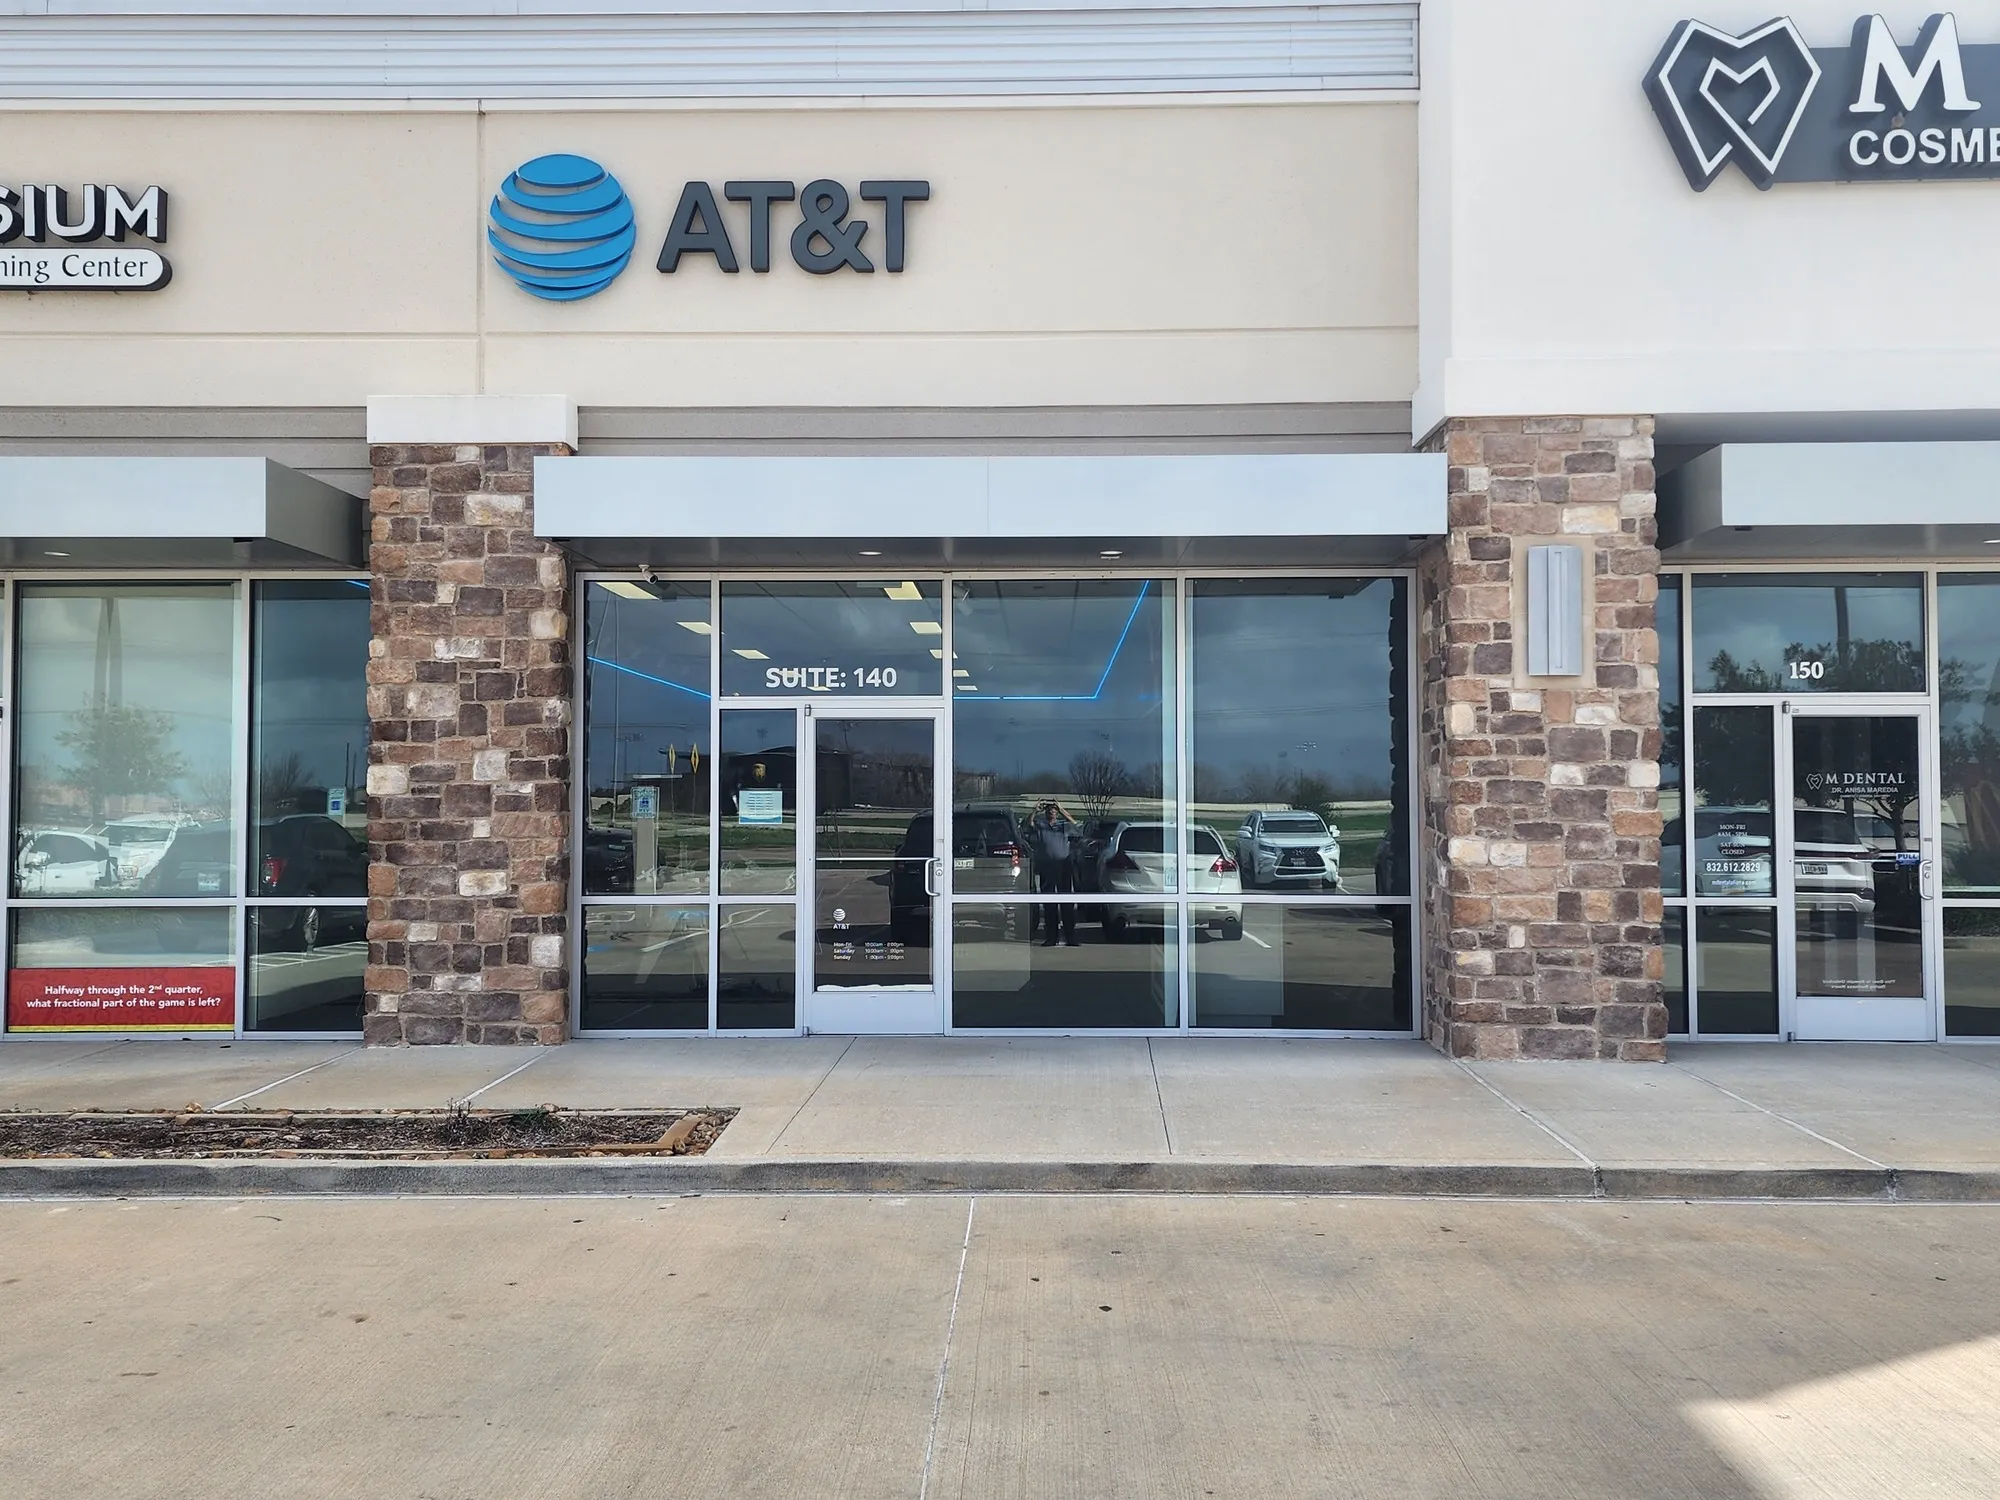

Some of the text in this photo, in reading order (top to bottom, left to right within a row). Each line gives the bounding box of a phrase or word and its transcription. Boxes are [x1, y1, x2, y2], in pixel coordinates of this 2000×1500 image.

[1849, 12, 1982, 112] M
[656, 179, 930, 274] AT&T
[62, 254, 148, 277] Center
[765, 667, 897, 688] SUITE: 140
[1789, 661, 1824, 679] 150
[1825, 773, 1906, 784] M DENTAL
[1706, 862, 1760, 872] 832.612.2829
[45, 985, 203, 996] Halfway through the 2nd quarter,
[26, 997, 221, 1009] what fractional part of the game is left?
